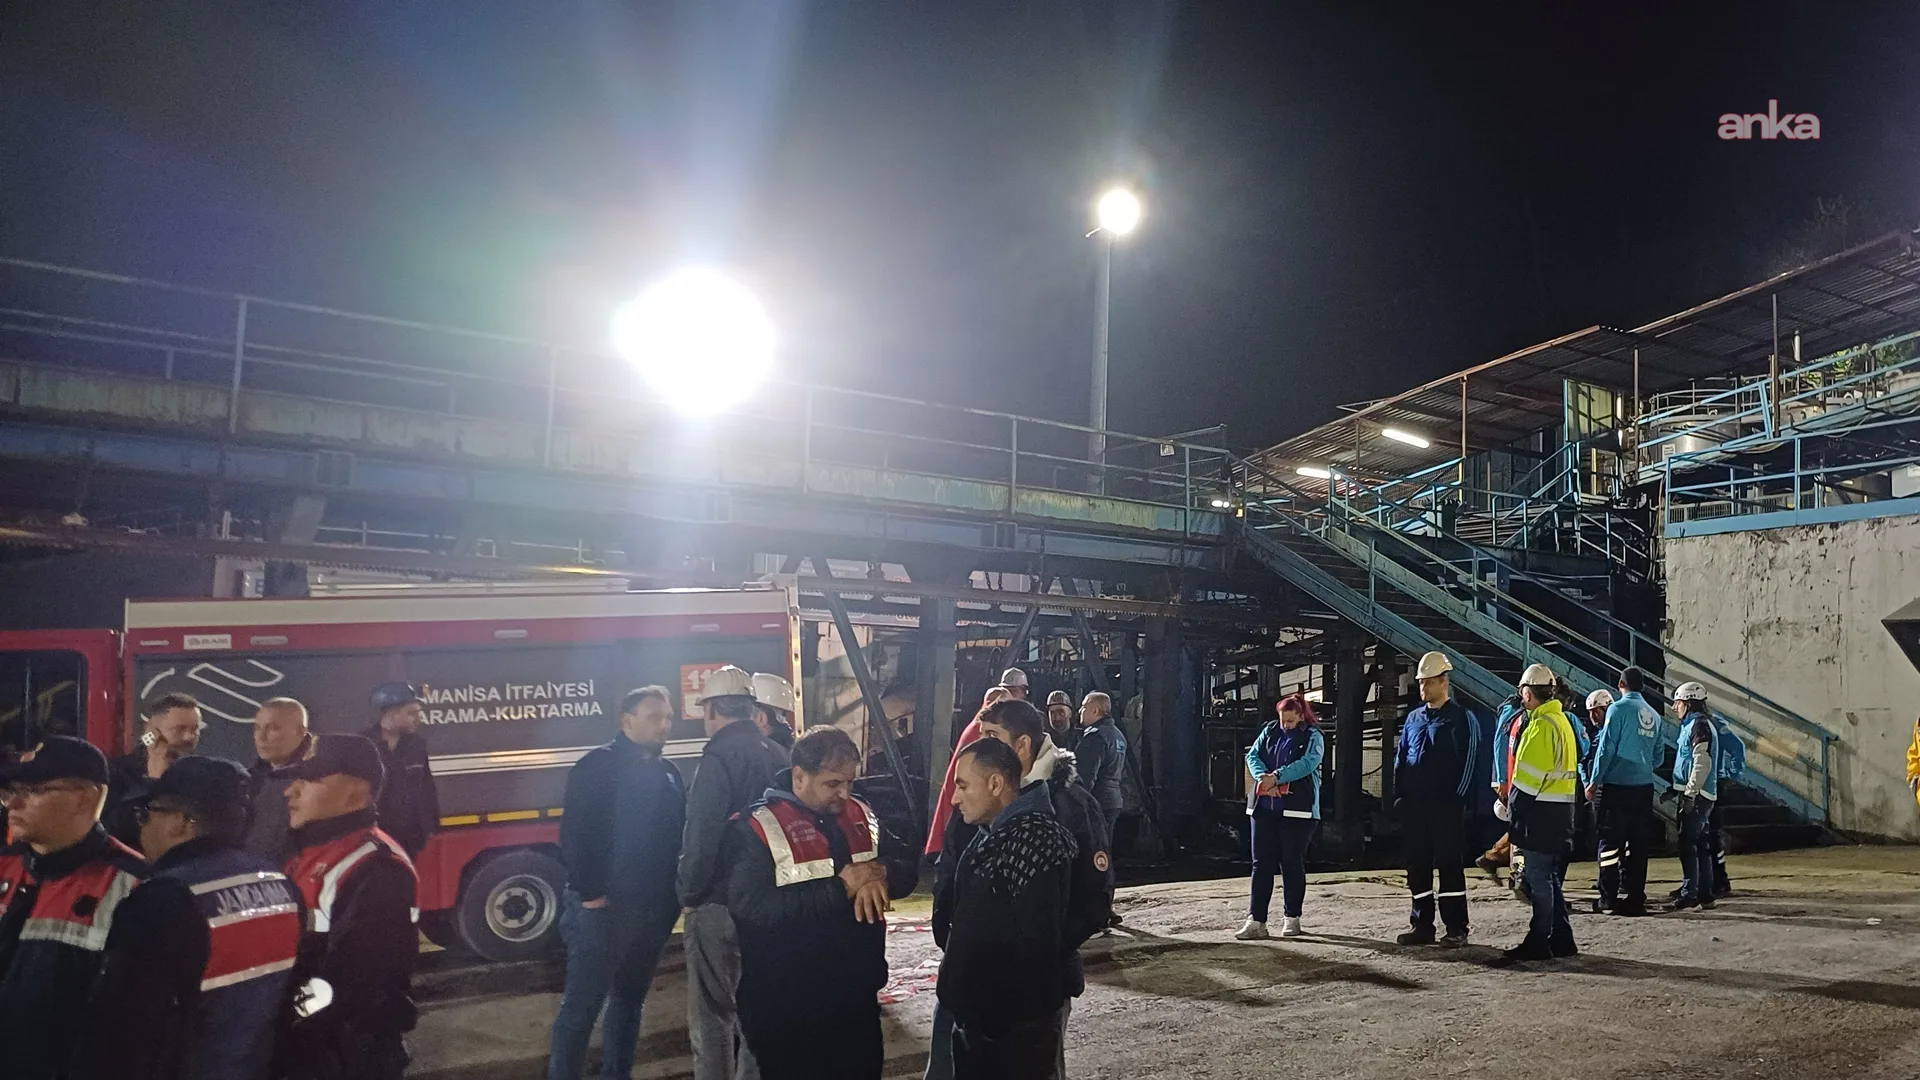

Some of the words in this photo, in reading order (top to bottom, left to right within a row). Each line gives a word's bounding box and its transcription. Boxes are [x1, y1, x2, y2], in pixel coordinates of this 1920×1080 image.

[420, 684, 502, 705] MANİSA
[505, 679, 594, 701] İTFAİYESİ
[418, 700, 604, 725] ARAMA-KURTARMA
